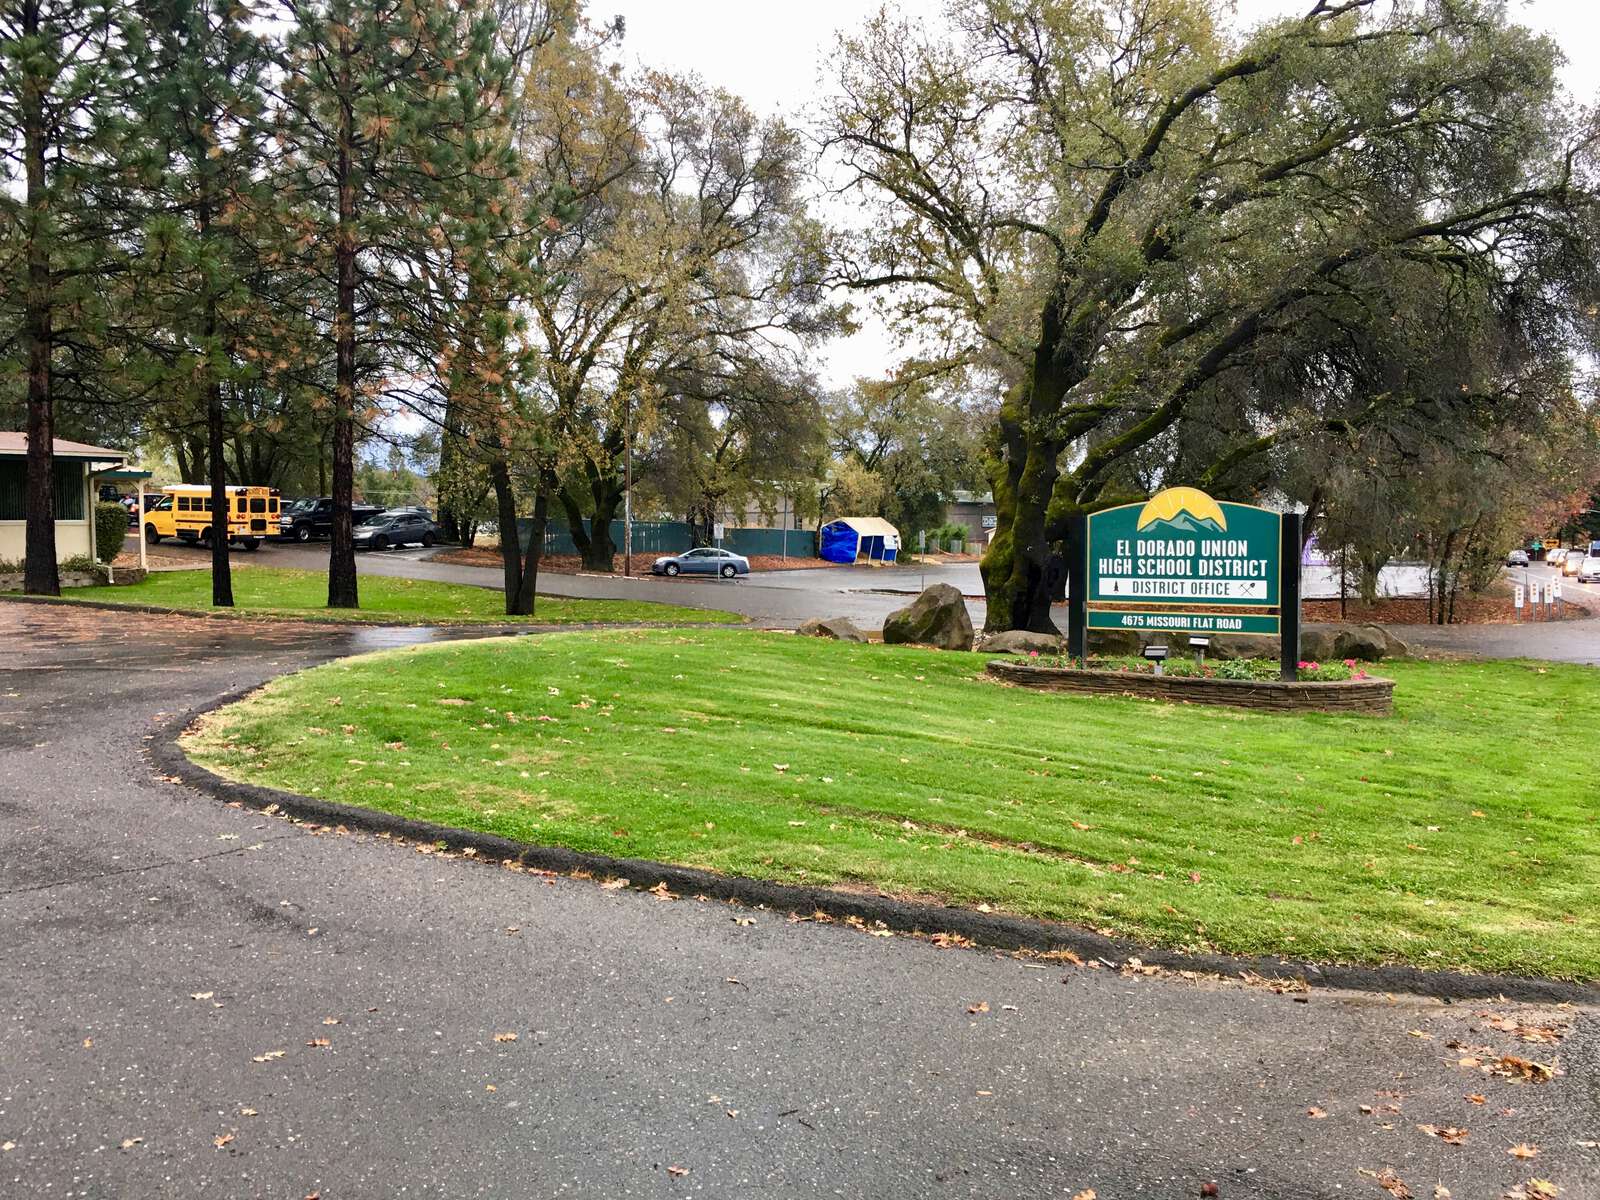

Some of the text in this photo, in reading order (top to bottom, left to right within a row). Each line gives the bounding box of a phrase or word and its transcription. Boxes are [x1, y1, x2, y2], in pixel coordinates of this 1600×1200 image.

[1116, 540, 1248, 557] EL DORADO UNION
[1099, 558, 1268, 577] HIGH SCHOOL DISTRICT
[1132, 580, 1230, 596] DISTRICT OFFICE
[1121, 615, 1242, 630] 4675 MISSOURI FLAT ROAD
